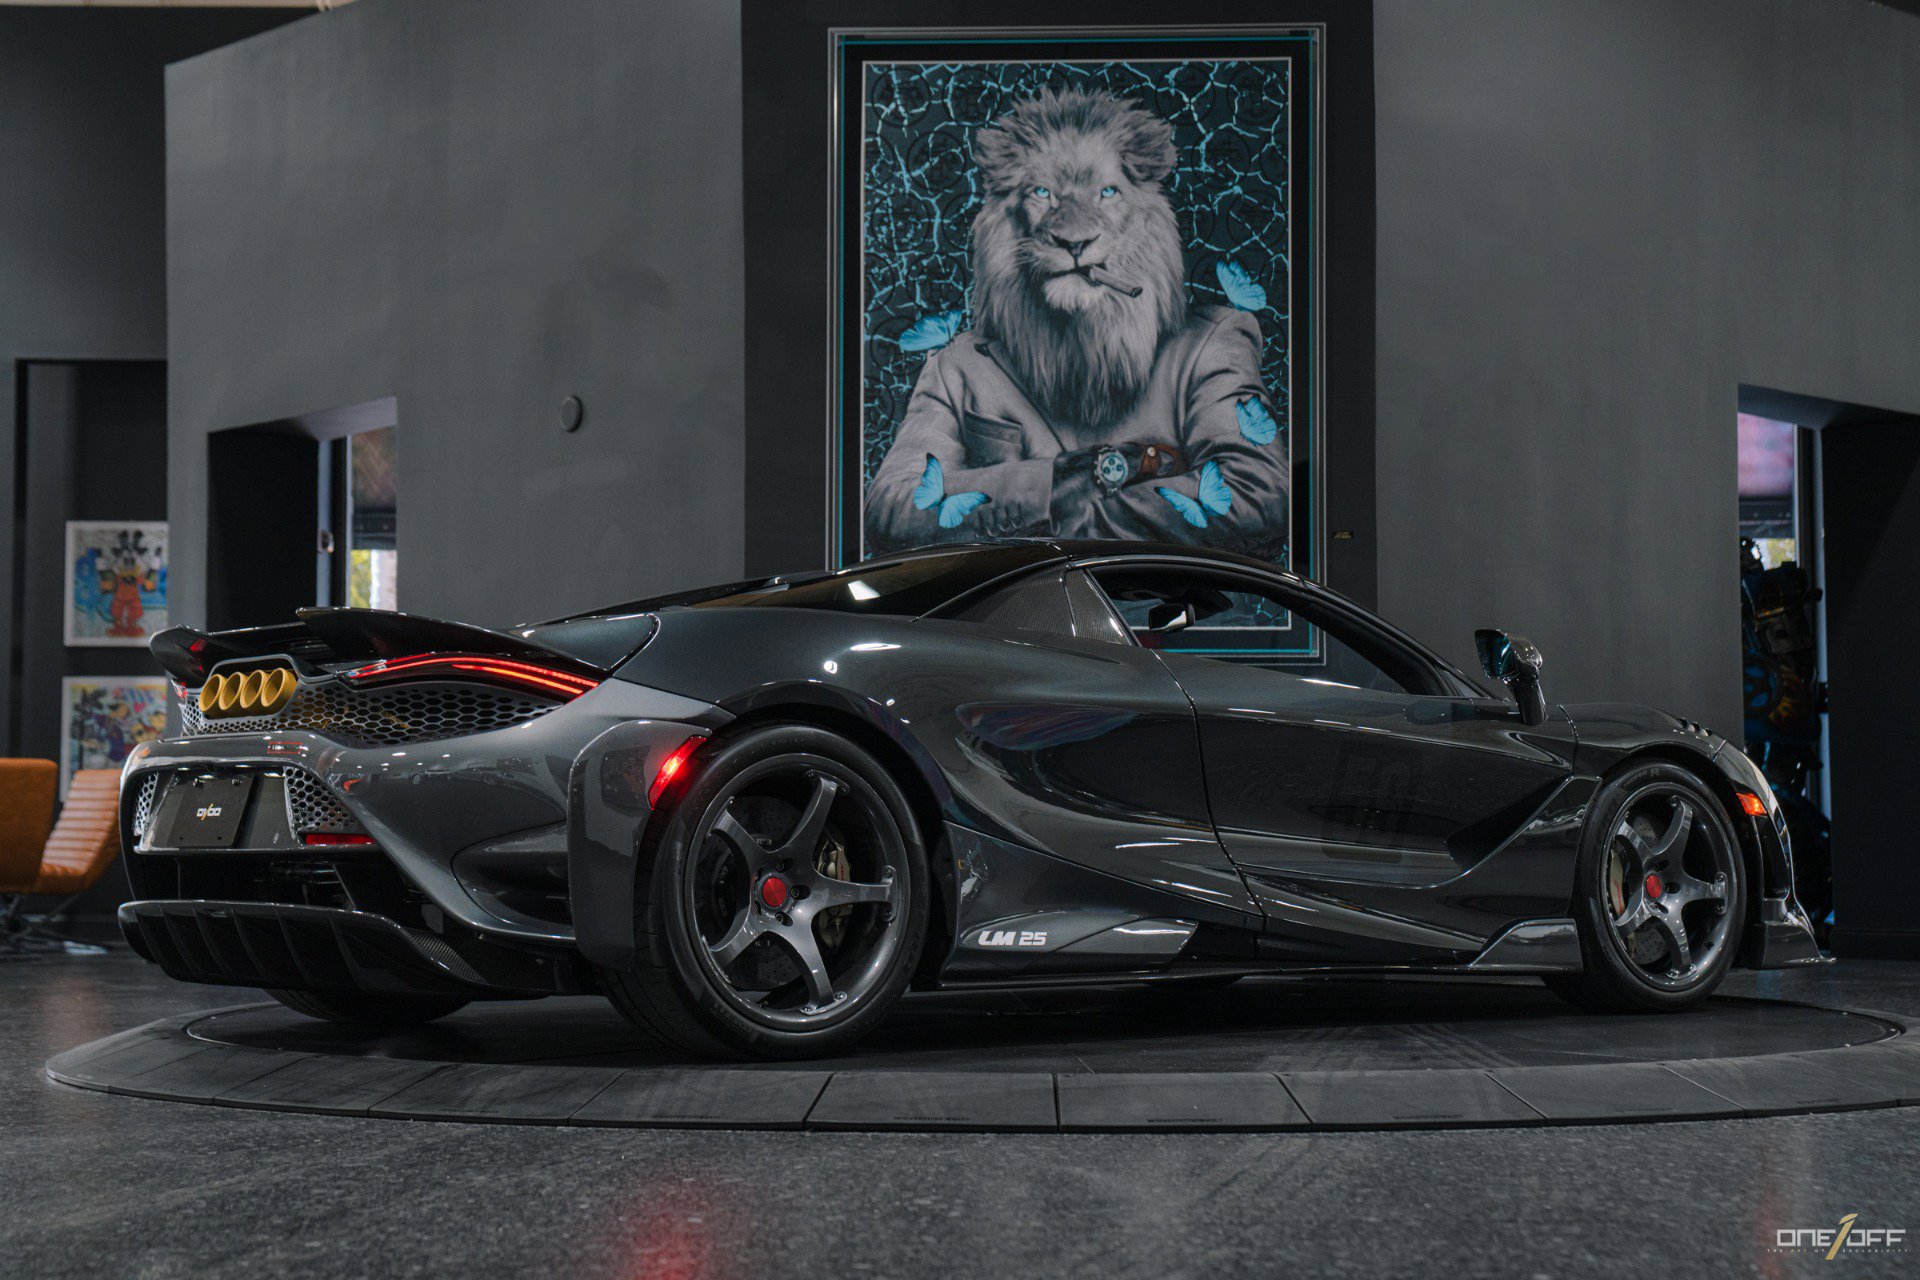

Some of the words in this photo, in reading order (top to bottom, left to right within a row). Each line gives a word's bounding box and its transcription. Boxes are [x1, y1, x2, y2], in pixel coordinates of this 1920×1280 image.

[1650, 767, 1660, 777] R
[978, 930, 1017, 946] LM
[1018, 931, 1048, 946] 25
